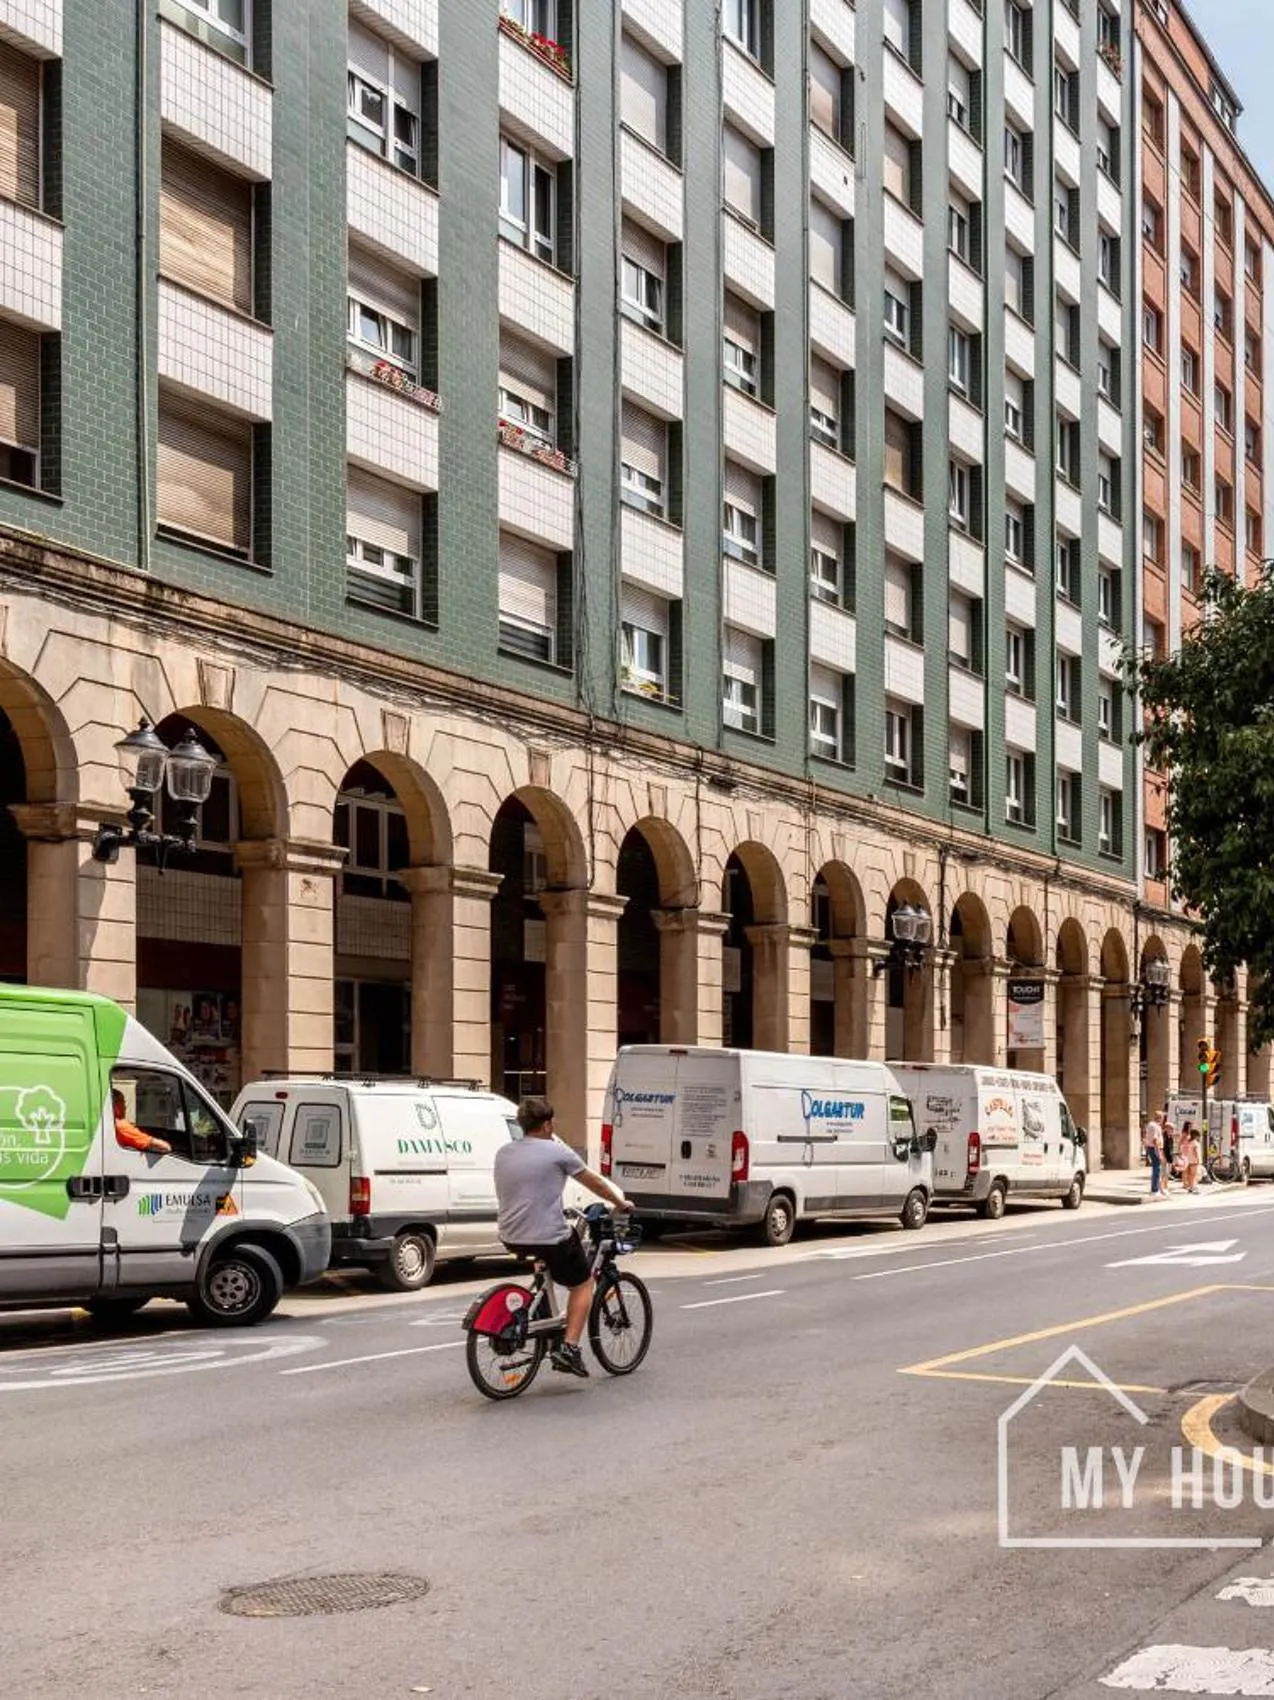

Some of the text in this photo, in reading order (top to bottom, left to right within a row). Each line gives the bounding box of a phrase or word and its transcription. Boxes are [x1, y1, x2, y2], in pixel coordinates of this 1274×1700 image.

[397, 1138, 473, 1155] DAMASCO
[16, 1150, 48, 1164] vida
[166, 1194, 211, 1207] EMULSA
